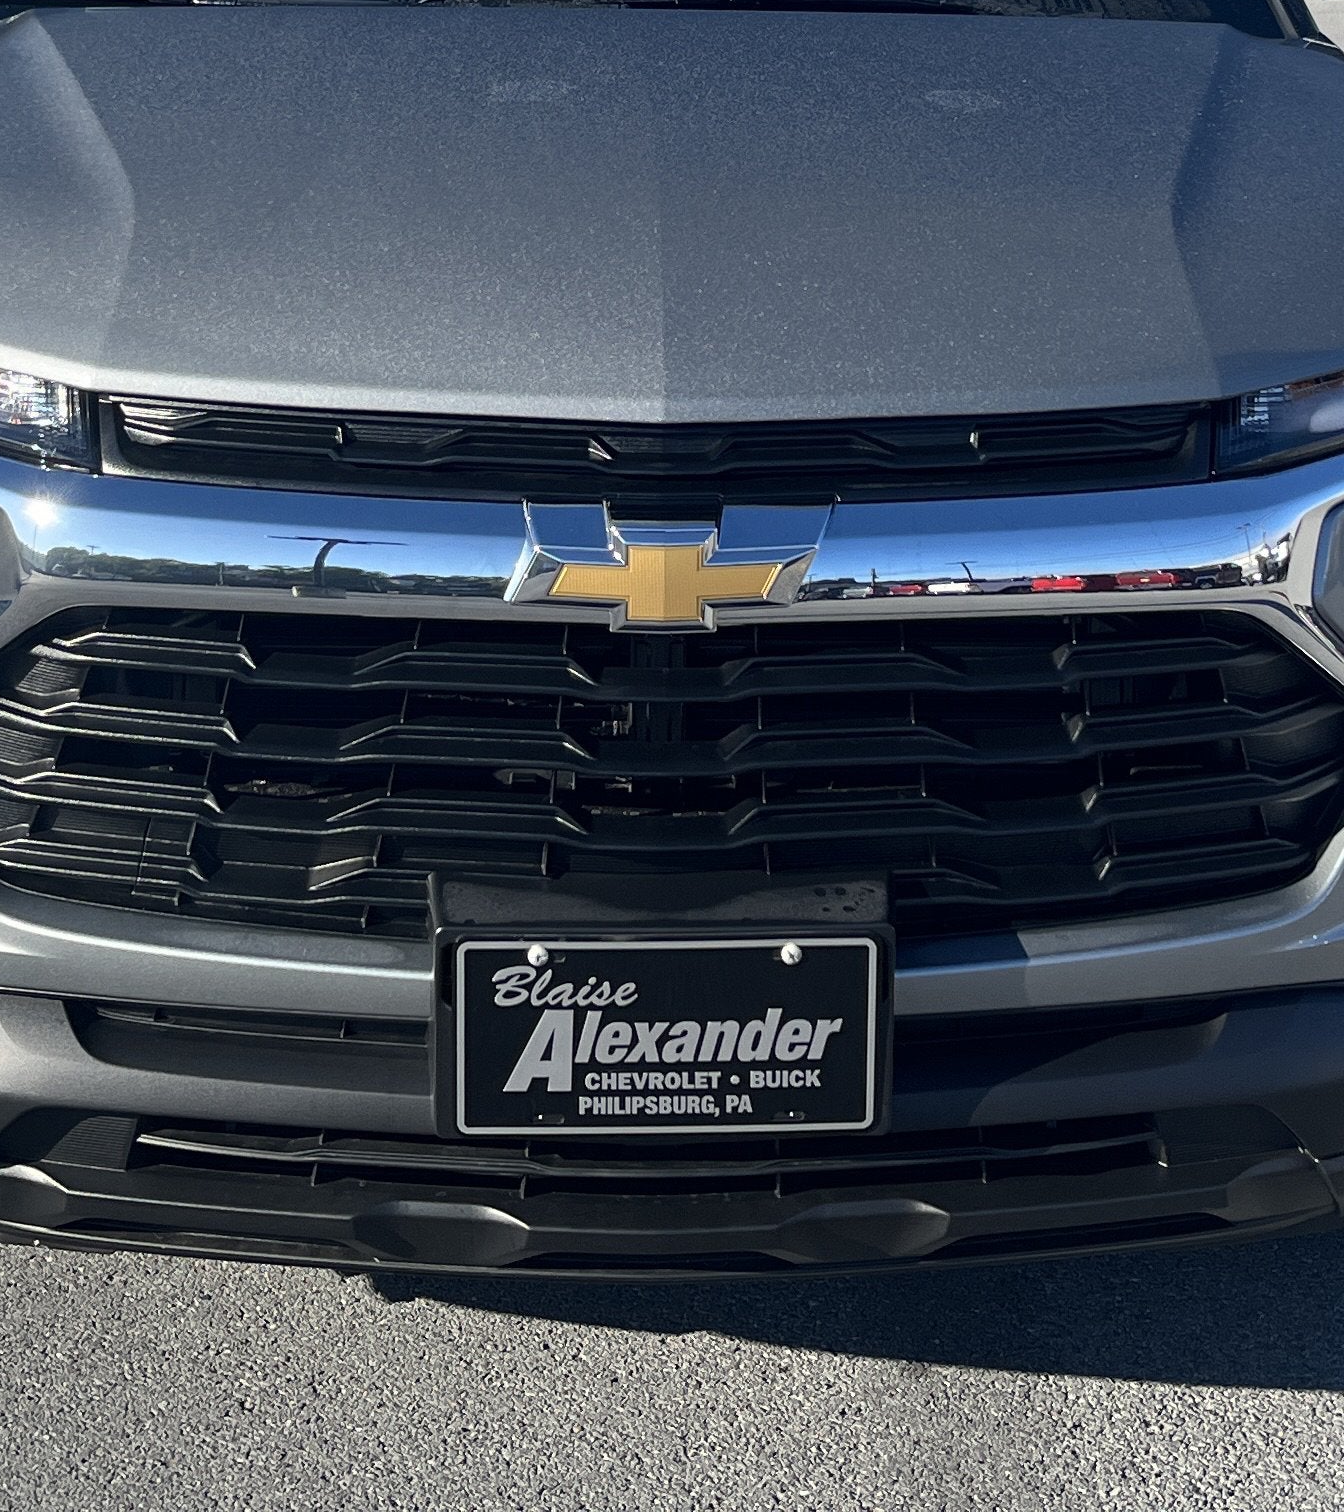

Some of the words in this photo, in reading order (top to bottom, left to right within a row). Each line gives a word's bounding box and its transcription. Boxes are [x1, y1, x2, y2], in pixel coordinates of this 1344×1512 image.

[492, 965, 638, 1008] Blaise
[502, 1007, 843, 1093] Alexander
[584, 1071, 721, 1091] CHEVROLET
[749, 1069, 821, 1088] BUICK
[578, 1095, 720, 1118] PHILIPSBURG,
[725, 1095, 753, 1114] PA
